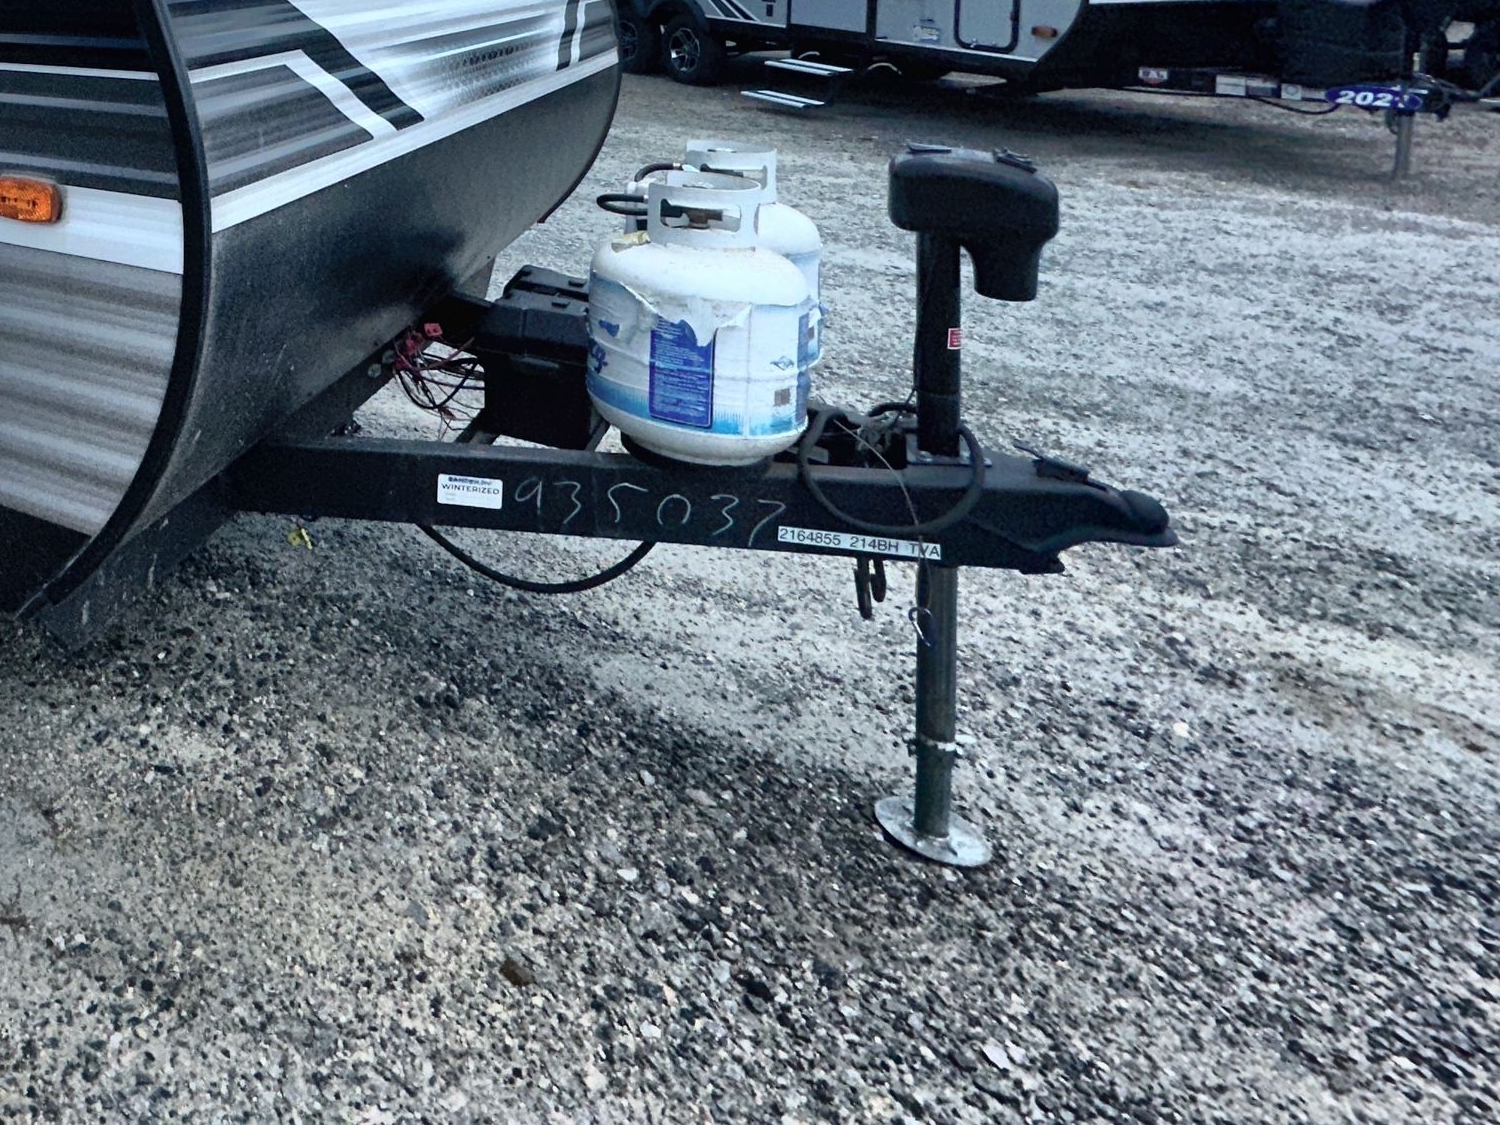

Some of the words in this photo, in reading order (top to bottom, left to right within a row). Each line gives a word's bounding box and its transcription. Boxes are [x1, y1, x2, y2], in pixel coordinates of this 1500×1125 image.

[441, 484, 500, 495] WINTERIZED
[779, 528, 841, 546] 2164855
[850, 536, 899, 553] 214BH
